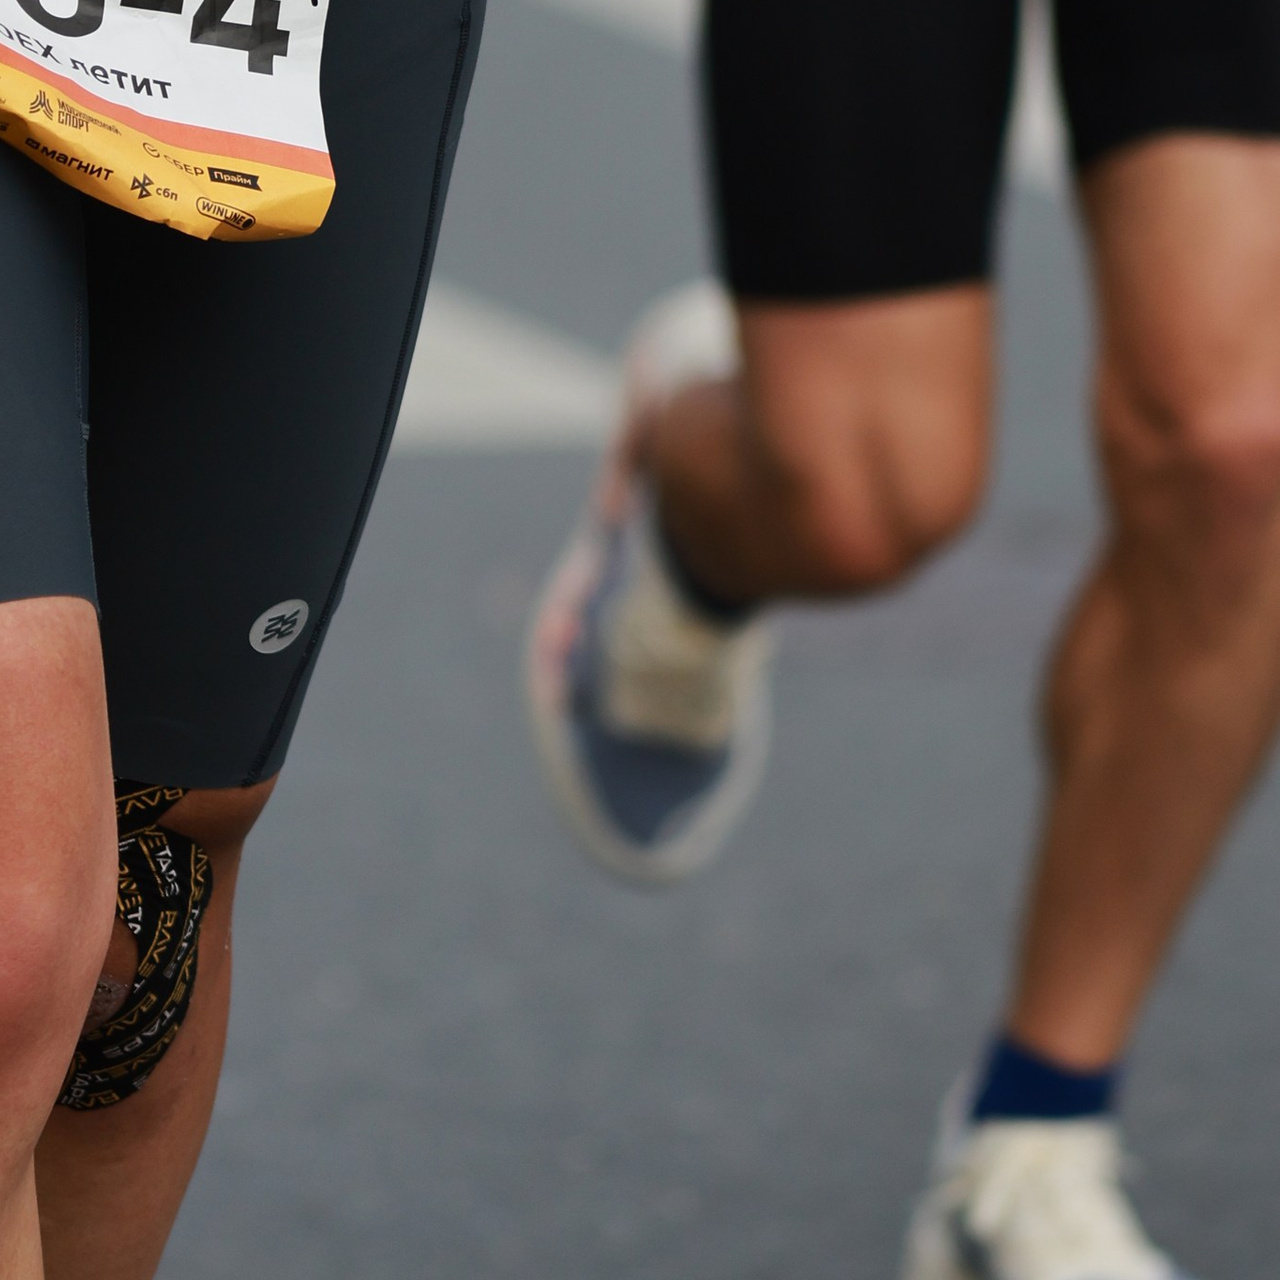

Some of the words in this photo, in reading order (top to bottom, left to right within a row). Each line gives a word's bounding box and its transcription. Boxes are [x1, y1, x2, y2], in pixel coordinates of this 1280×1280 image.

[69, 57, 173, 100] летит
[58, 110, 90, 133] СПОРТ
[213, 171, 253, 186] Прайм
[155, 187, 179, 202] сбп
[201, 200, 247, 226] WINLINE
